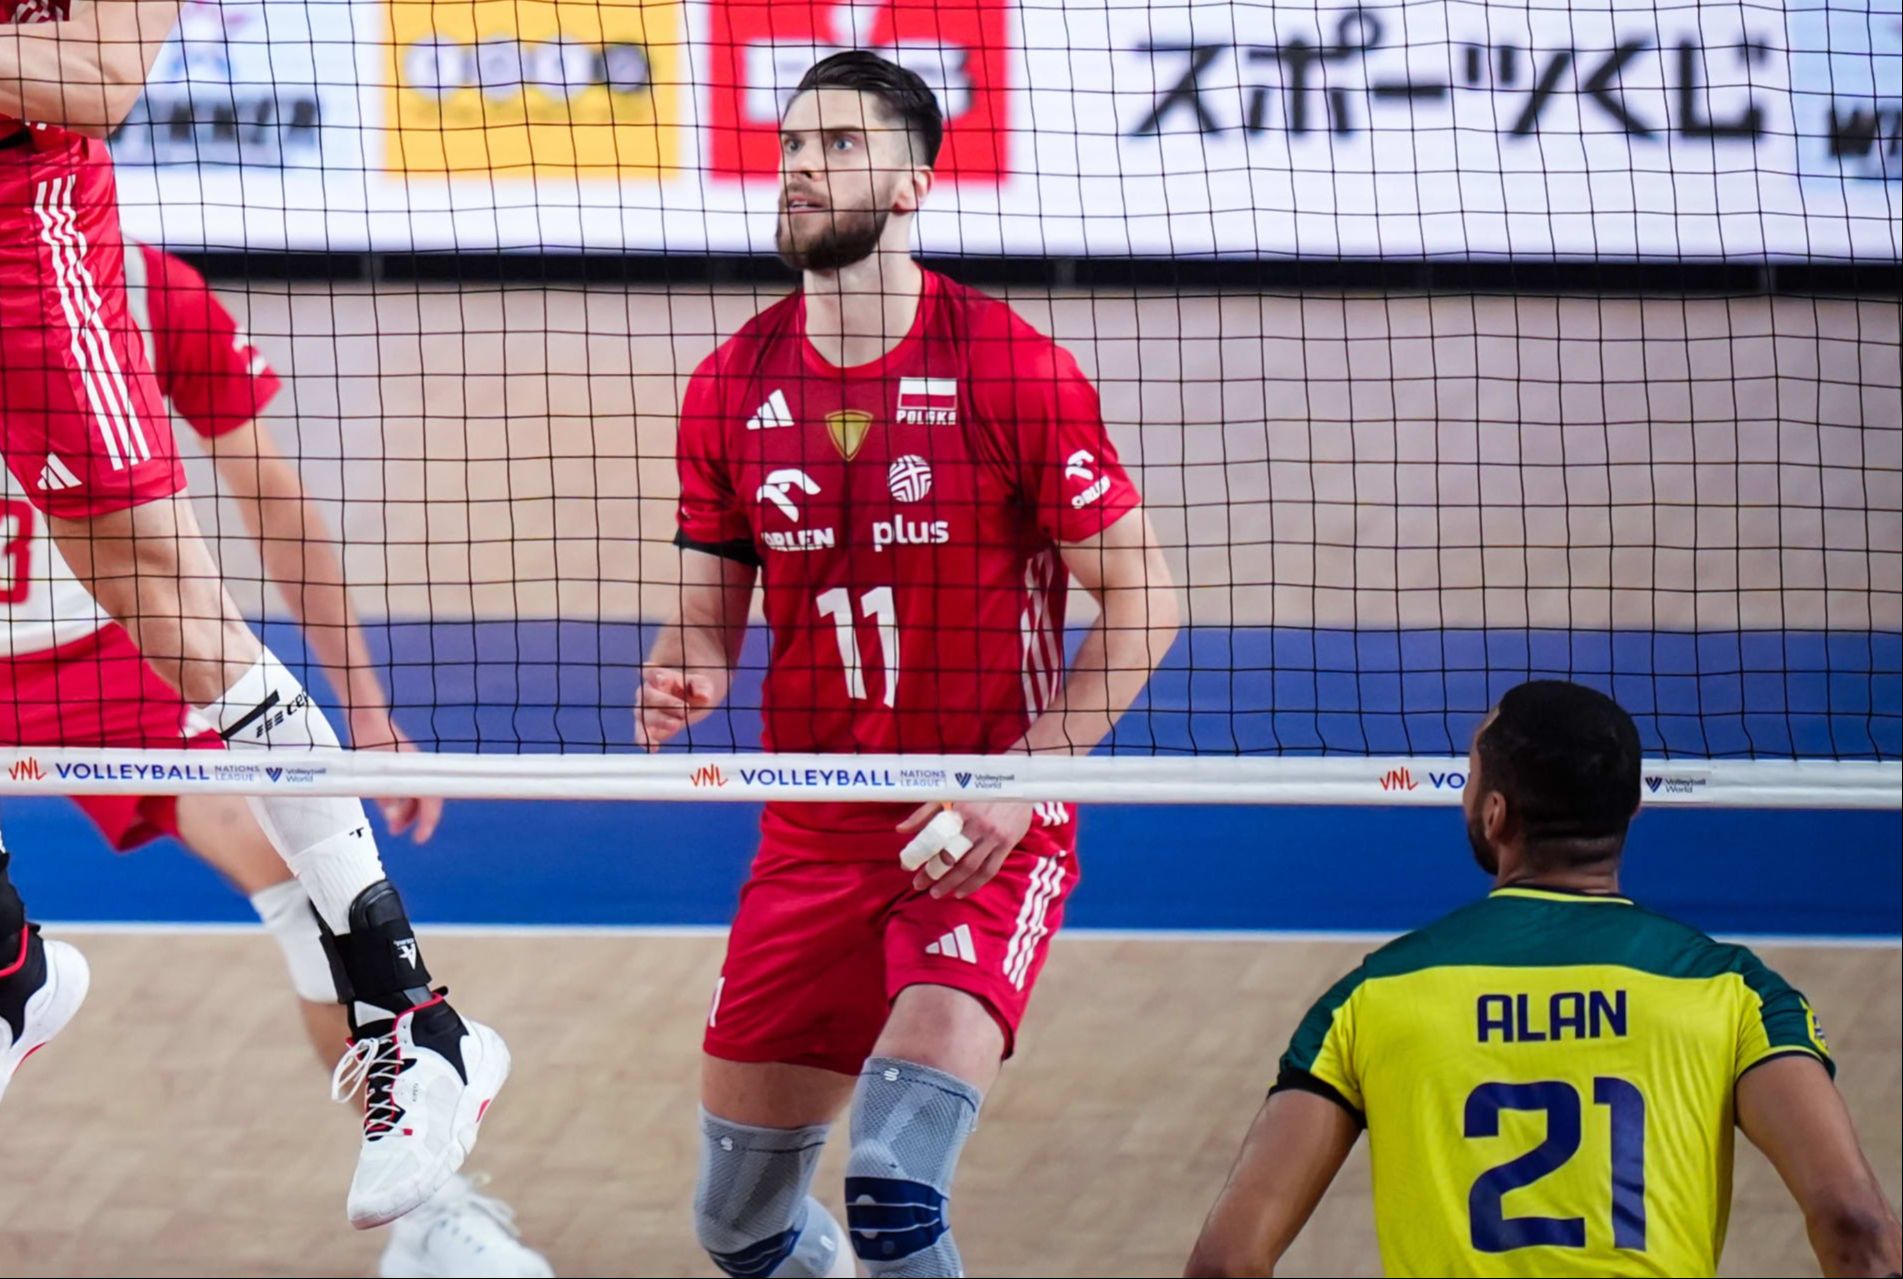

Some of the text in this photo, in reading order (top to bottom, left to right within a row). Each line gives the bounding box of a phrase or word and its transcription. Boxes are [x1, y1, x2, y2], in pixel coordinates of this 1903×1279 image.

[1128, 4, 1771, 141] スポーツくじ
[896, 409, 957, 426] POLSKA
[872, 513, 950, 553] plus
[815, 585, 900, 709] 11
[54, 762, 211, 781] VOLLEYBALL
[739, 768, 896, 787] VOLLEYBALL
[1476, 988, 1628, 1044] ALAN
[1462, 1076, 1648, 1254] 21
